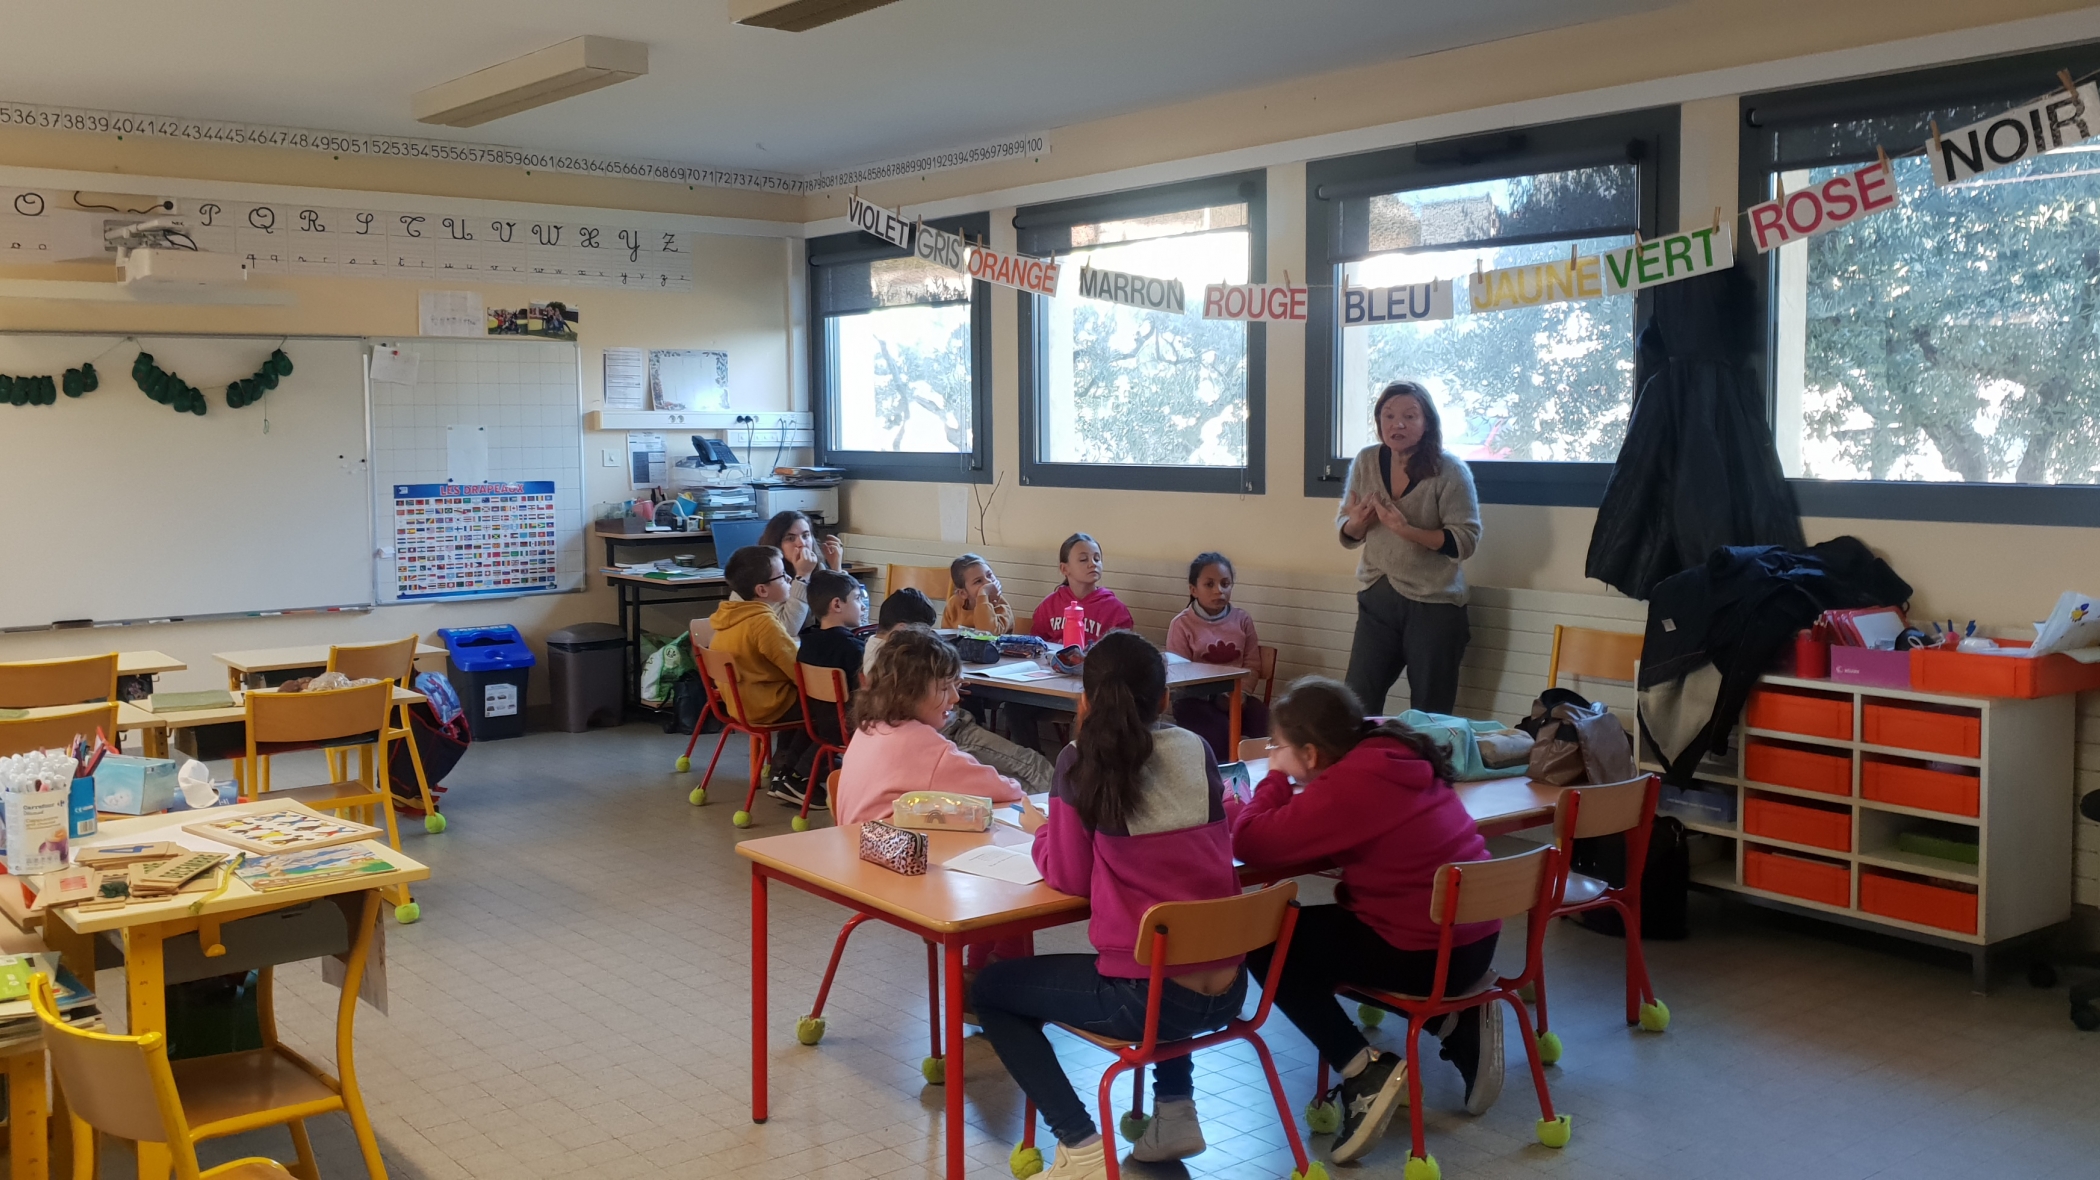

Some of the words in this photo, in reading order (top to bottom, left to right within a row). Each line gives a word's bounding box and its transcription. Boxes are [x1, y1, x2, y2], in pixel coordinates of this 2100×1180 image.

[14, 109, 36, 125] 36
[39, 112, 60, 128] 37
[64, 114, 85, 130] 38
[88, 116, 109, 131] 39
[112, 118, 133, 133] 40
[136, 119, 154, 135] 41
[158, 122, 178, 136] 42
[182, 125, 202, 140] 43
[204, 126, 223, 142] 44
[225, 128, 244, 143] 45
[248, 130, 266, 144] 46
[269, 132, 287, 146] 47
[290, 134, 308, 148] 48
[311, 135, 329, 150] 49
[332, 138, 349, 152] 50
[352, 140, 368, 153] 51
[373, 141, 390, 154] 52
[391, 142, 409, 156] 53
[411, 143, 428, 157] 54
[431, 145, 449, 158] 55
[450, 147, 467, 161] 56
[469, 149, 485, 162] 57
[487, 150, 503, 163] 58
[505, 152, 522, 165] 59
[523, 154, 538, 166] 60
[540, 155, 554, 168] 61
[558, 157, 573, 169] 62
[574, 158, 588, 170] 63
[590, 160, 604, 172] 64
[606, 162, 622, 173] 65
[623, 164, 637, 175] 66
[638, 164, 653, 176] 67
[655, 166, 668, 178] 68
[670, 167, 684, 179] 69
[687, 169, 700, 180] 70
[702, 170, 714, 182] 71
[718, 172, 731, 184] 72
[733, 173, 746, 185] 73
[748, 174, 760, 187] 74
[762, 176, 774, 188] 75
[776, 178, 789, 190] 76
[791, 180, 803, 191] 77
[805, 181, 813, 191] 78
[814, 179, 821, 189] 79
[822, 177, 830, 188] 80
[830, 176, 838, 186] 81
[839, 173, 848, 185] 82
[849, 172, 857, 183] 83
[858, 171, 867, 182] 84
[868, 168, 876, 180] 85
[877, 167, 886, 178] 86
[887, 165, 896, 176] 87
[896, 163, 905, 174] 88
[906, 161, 915, 173] 89
[916, 159, 926, 171] 90
[927, 157, 935, 169] 91
[937, 155, 947, 168] 92
[948, 154, 958, 166] 93
[959, 152, 968, 164] 94
[969, 149, 979, 162] 95
[980, 148, 990, 160] 96
[991, 145, 1001, 158] 97
[1002, 143, 1013, 156] 98
[1014, 140, 1024, 154] 99
[1027, 138, 1042, 152] 100
[1940, 96, 2091, 182] NOIR
[14, 193, 44, 216] O
[199, 204, 221, 226] P
[249, 207, 274, 233] Q
[300, 210, 325, 232] R
[442, 218, 473, 240] U
[492, 221, 516, 242] V
[532, 224, 563, 245] W
[662, 233, 678, 252] Z
[849, 197, 908, 246] VIOLET
[1752, 163, 1893, 248] ROSE
[917, 228, 962, 269] GRIS
[968, 249, 1057, 293] ORANGE
[1606, 227, 1719, 288] VERT
[1080, 269, 1184, 311] MARRON
[1204, 287, 1307, 320] ROUGE
[1345, 284, 1431, 323] BLEU
[1474, 257, 1601, 310] JAUNE
[440, 485, 460, 496] LES
[464, 484, 524, 495] DRAPEAUX
